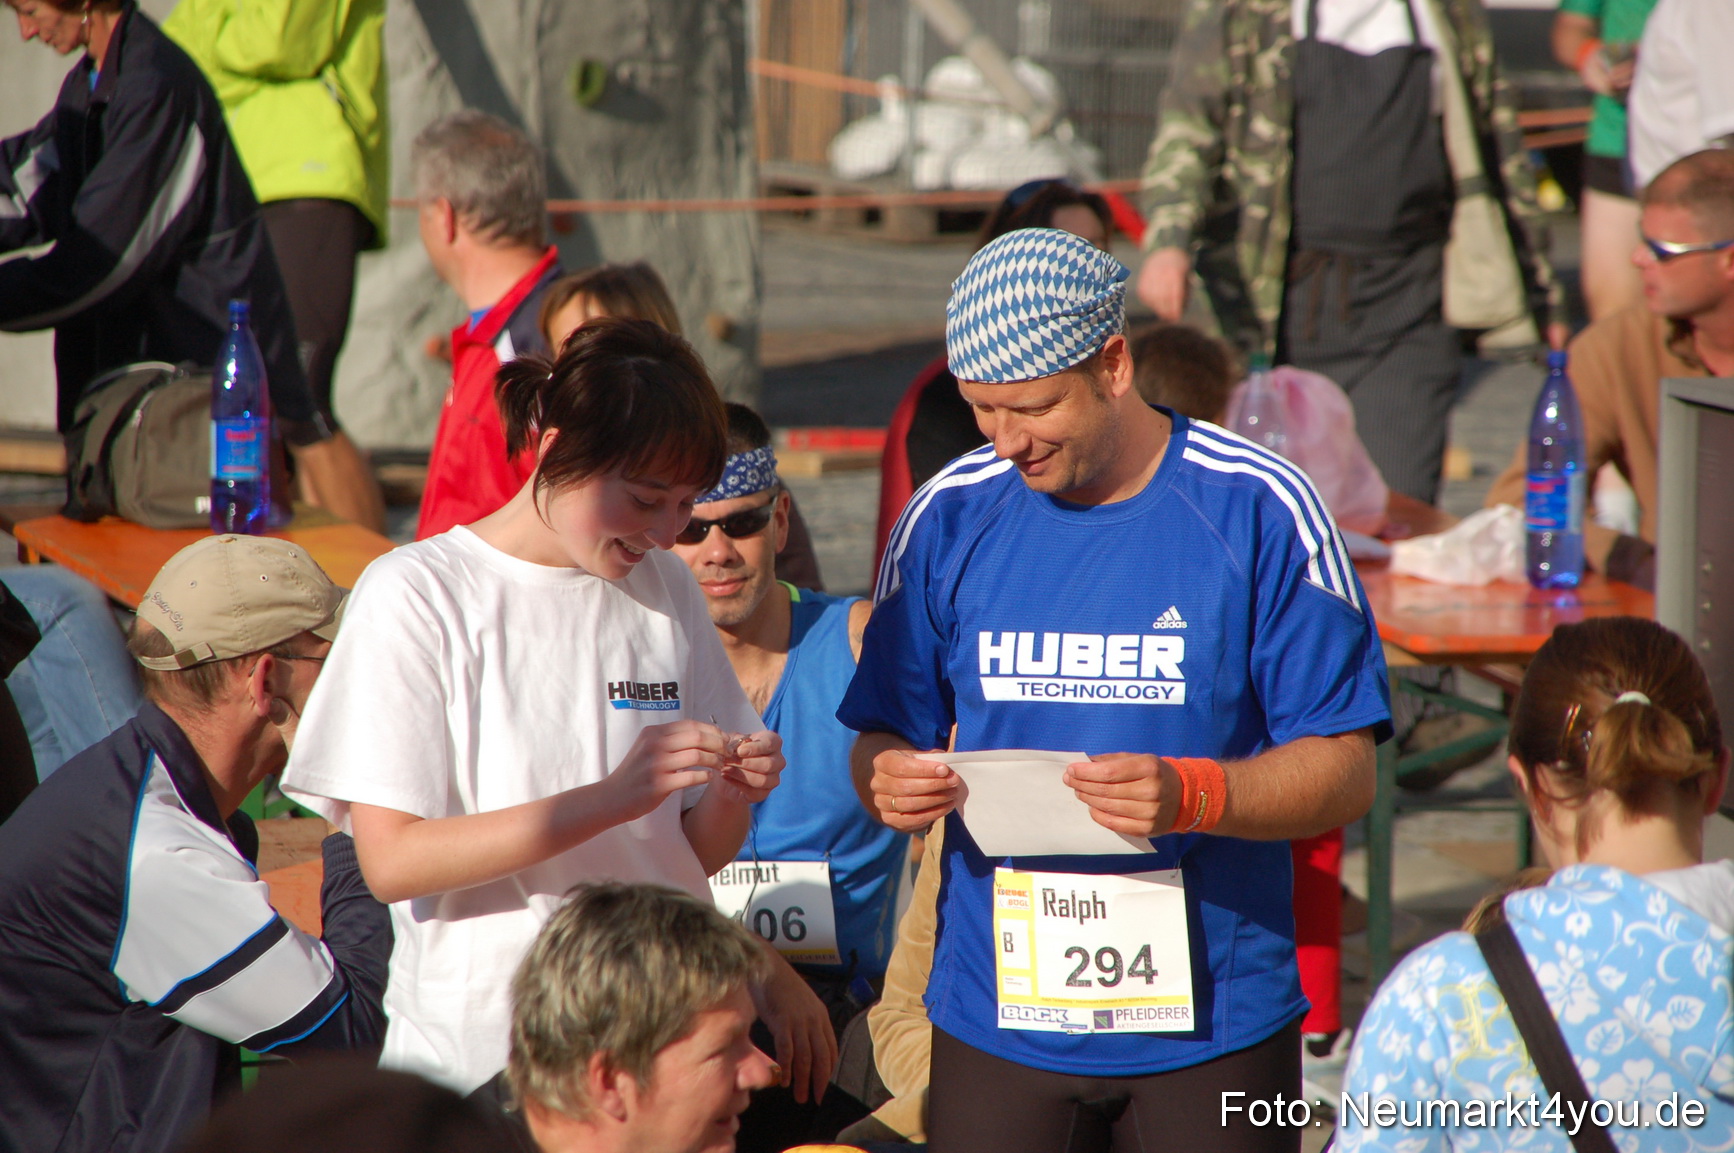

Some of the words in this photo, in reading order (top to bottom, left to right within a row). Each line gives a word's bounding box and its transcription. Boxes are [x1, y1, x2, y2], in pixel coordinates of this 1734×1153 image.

[1152, 620, 1188, 629] adidas
[979, 631, 1185, 680] HUBER
[608, 681, 679, 700] HUBER
[1017, 682, 1176, 700] TECHNOLOGY
[628, 701, 676, 709] TECHNOLOGY
[1042, 887, 1107, 925] Ralph
[730, 905, 808, 943] 06
[1003, 931, 1015, 952] B
[1064, 944, 1158, 988] 294
[1002, 1005, 1069, 1024] BOCK
[1116, 1007, 1190, 1021] PFLEIDERER
